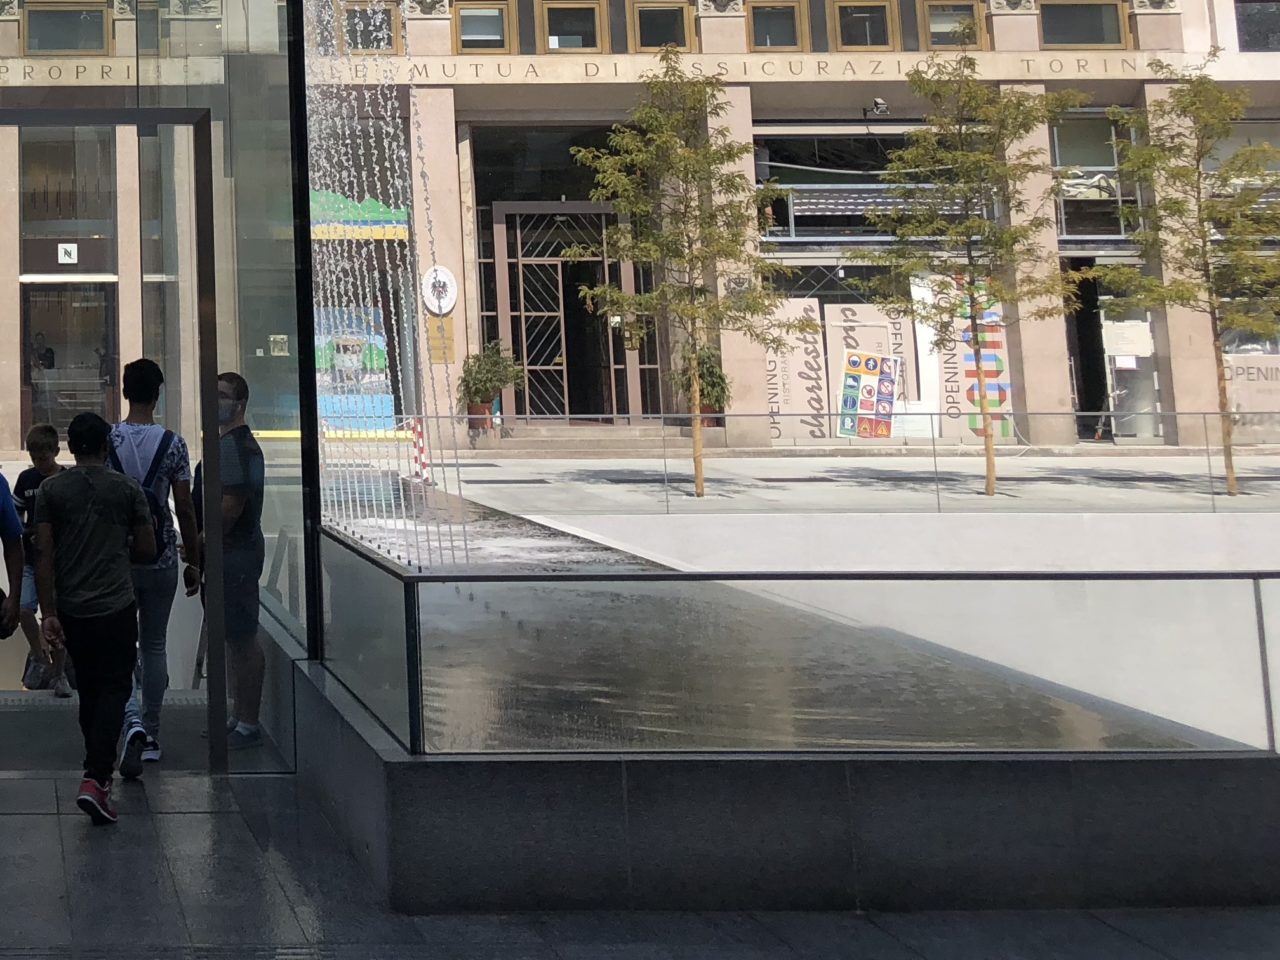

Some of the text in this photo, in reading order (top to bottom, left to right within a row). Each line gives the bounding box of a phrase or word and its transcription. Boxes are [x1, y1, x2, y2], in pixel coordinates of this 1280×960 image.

[409, 63, 539, 78] MUTUA
[585, 62, 619, 77] DI
[1021, 59, 1164, 74] TORIN
[796, 304, 826, 439] charlestn
